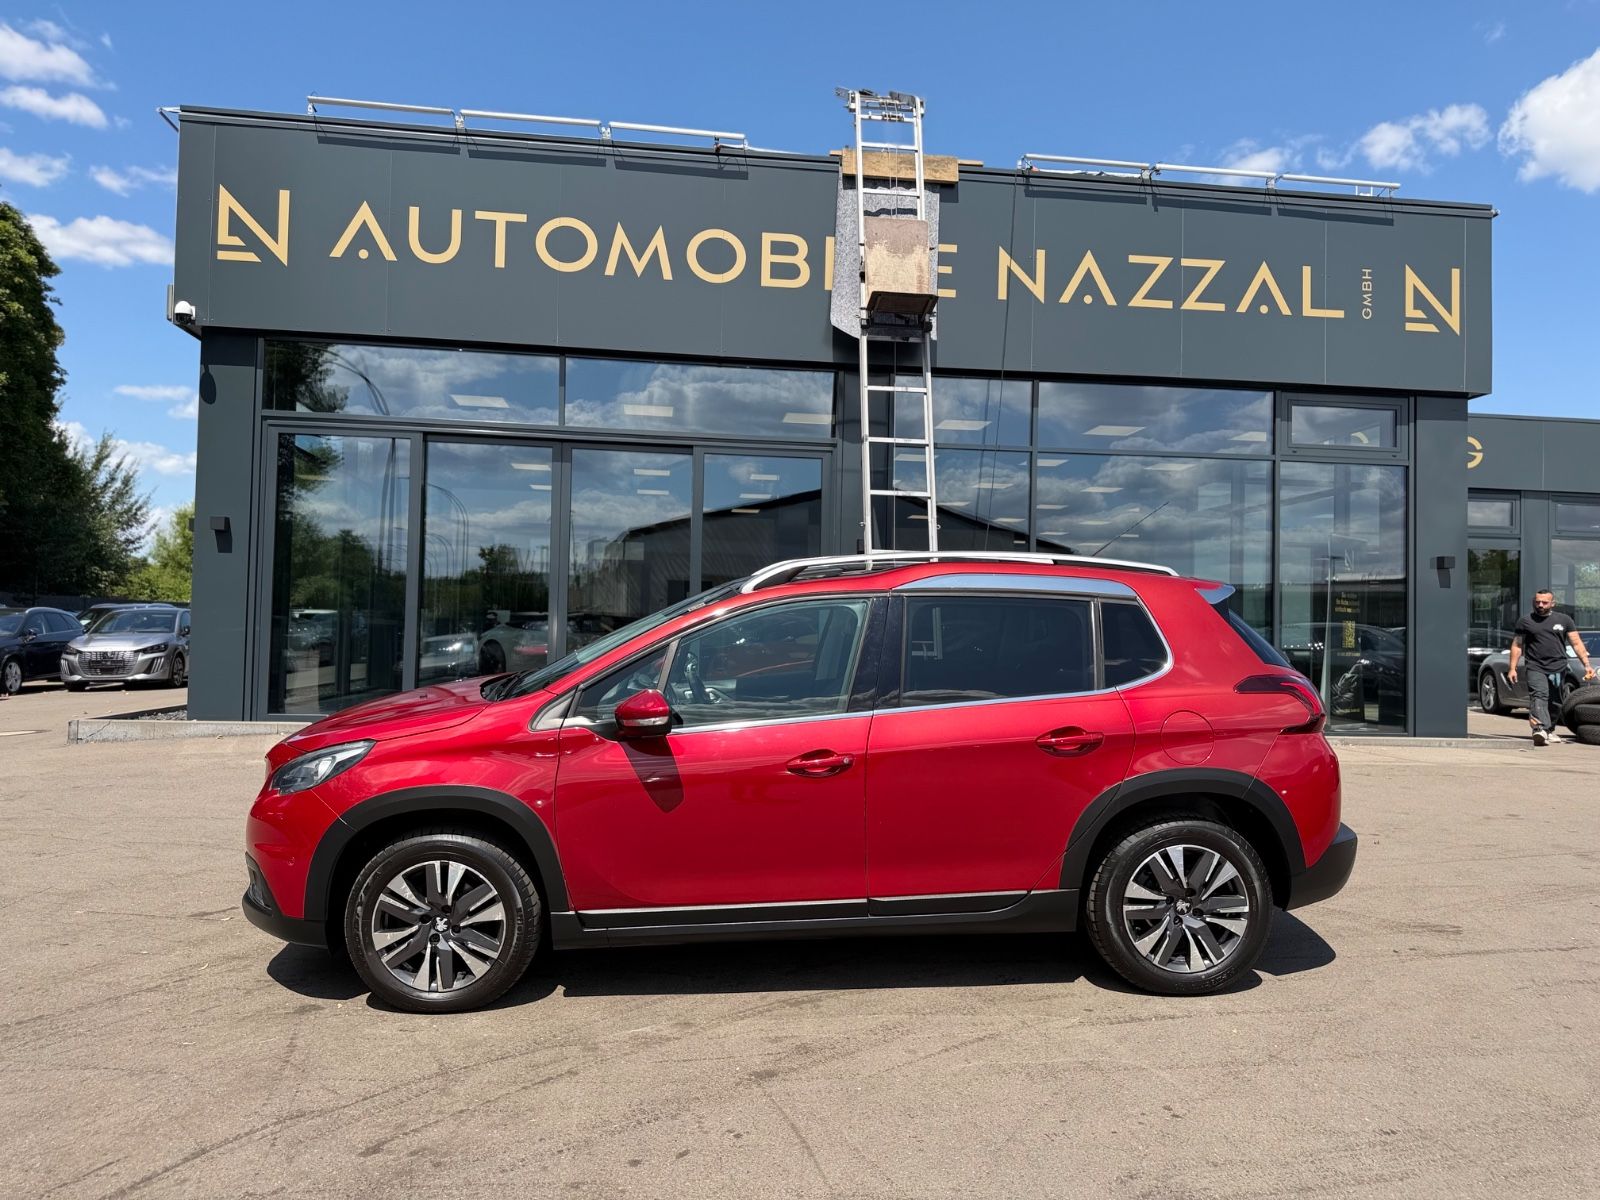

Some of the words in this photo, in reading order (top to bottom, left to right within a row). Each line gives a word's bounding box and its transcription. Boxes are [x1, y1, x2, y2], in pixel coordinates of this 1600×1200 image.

[330, 201, 958, 299] AUTOMOBIE
[997, 247, 1345, 319] NAZZAL
[1361, 268, 1373, 320] GMBH
